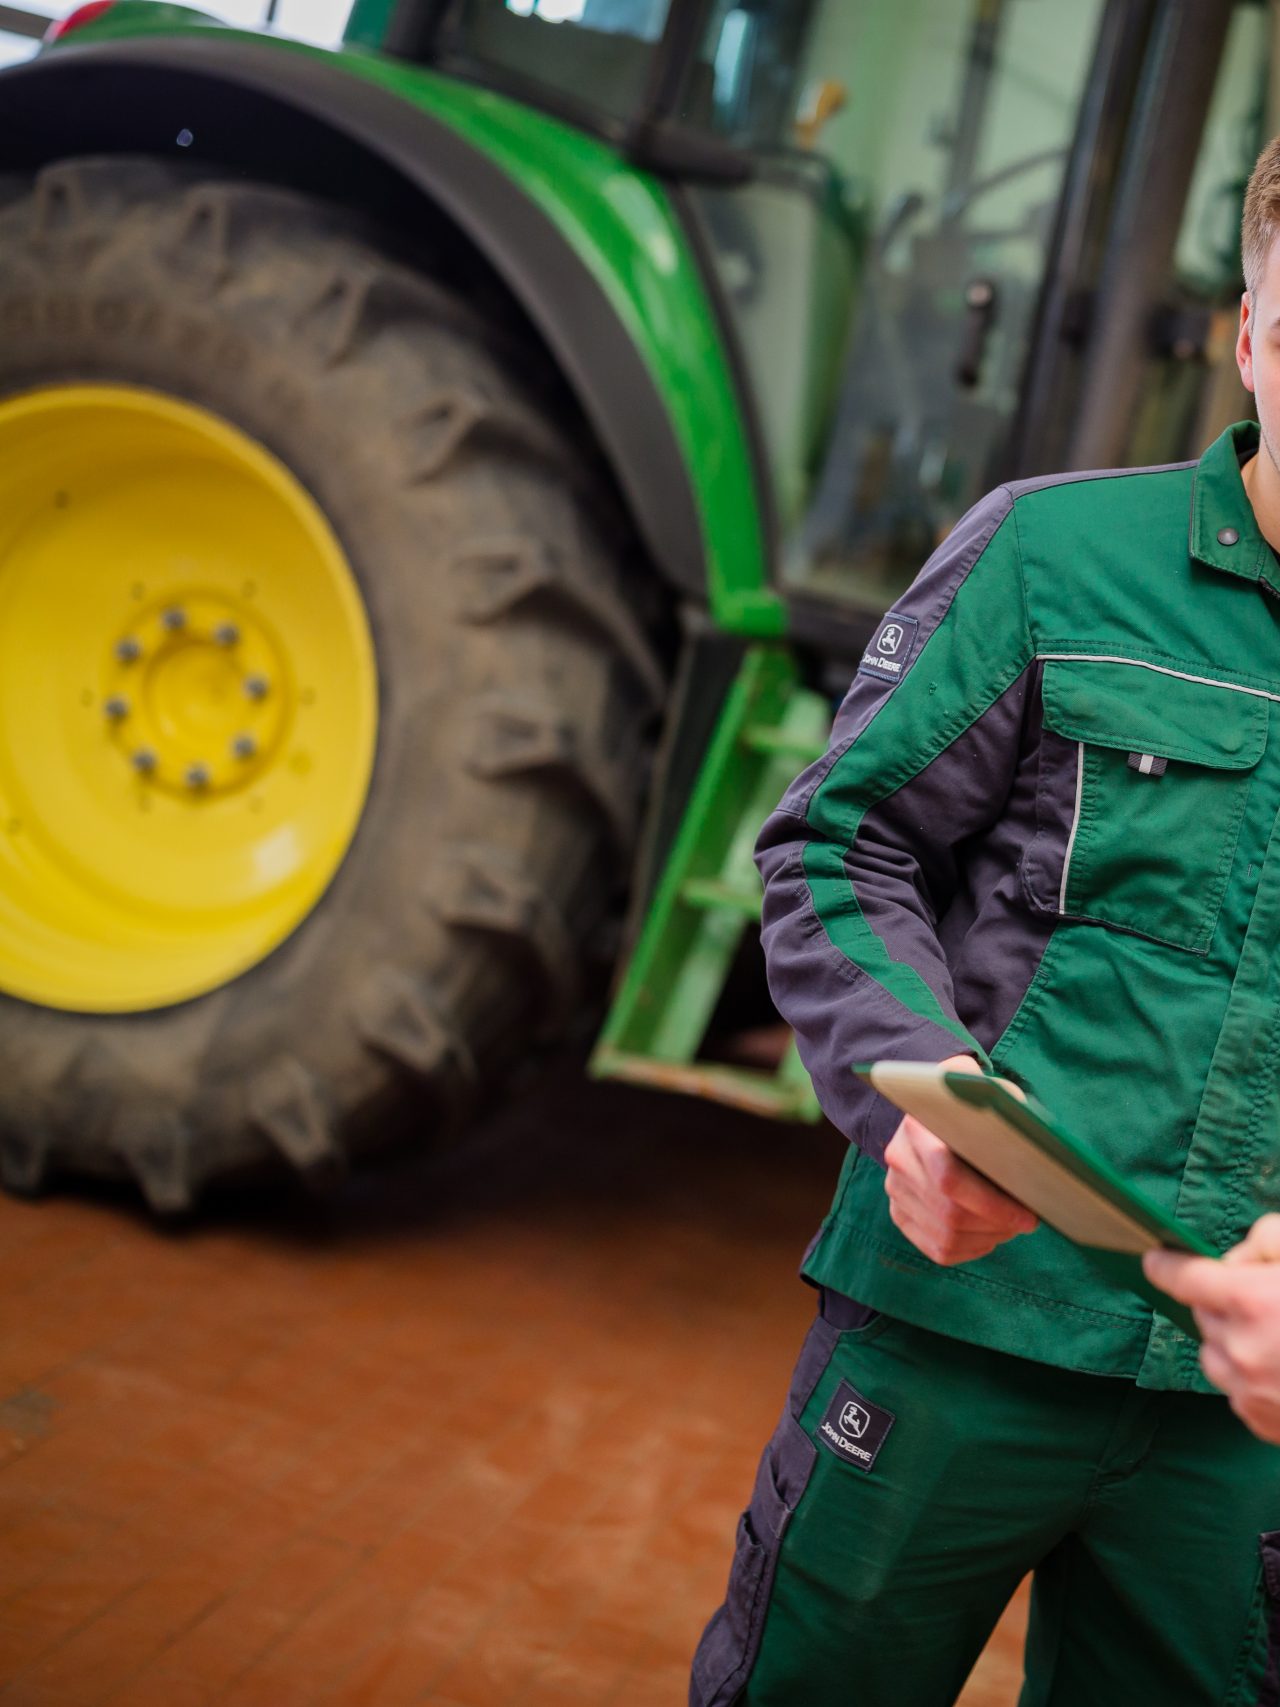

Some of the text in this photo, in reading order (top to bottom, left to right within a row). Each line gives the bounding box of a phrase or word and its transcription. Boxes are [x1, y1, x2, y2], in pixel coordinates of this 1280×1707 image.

[877, 657, 902, 672] DEERE
[821, 1421, 873, 1462] JOHN DEERE
